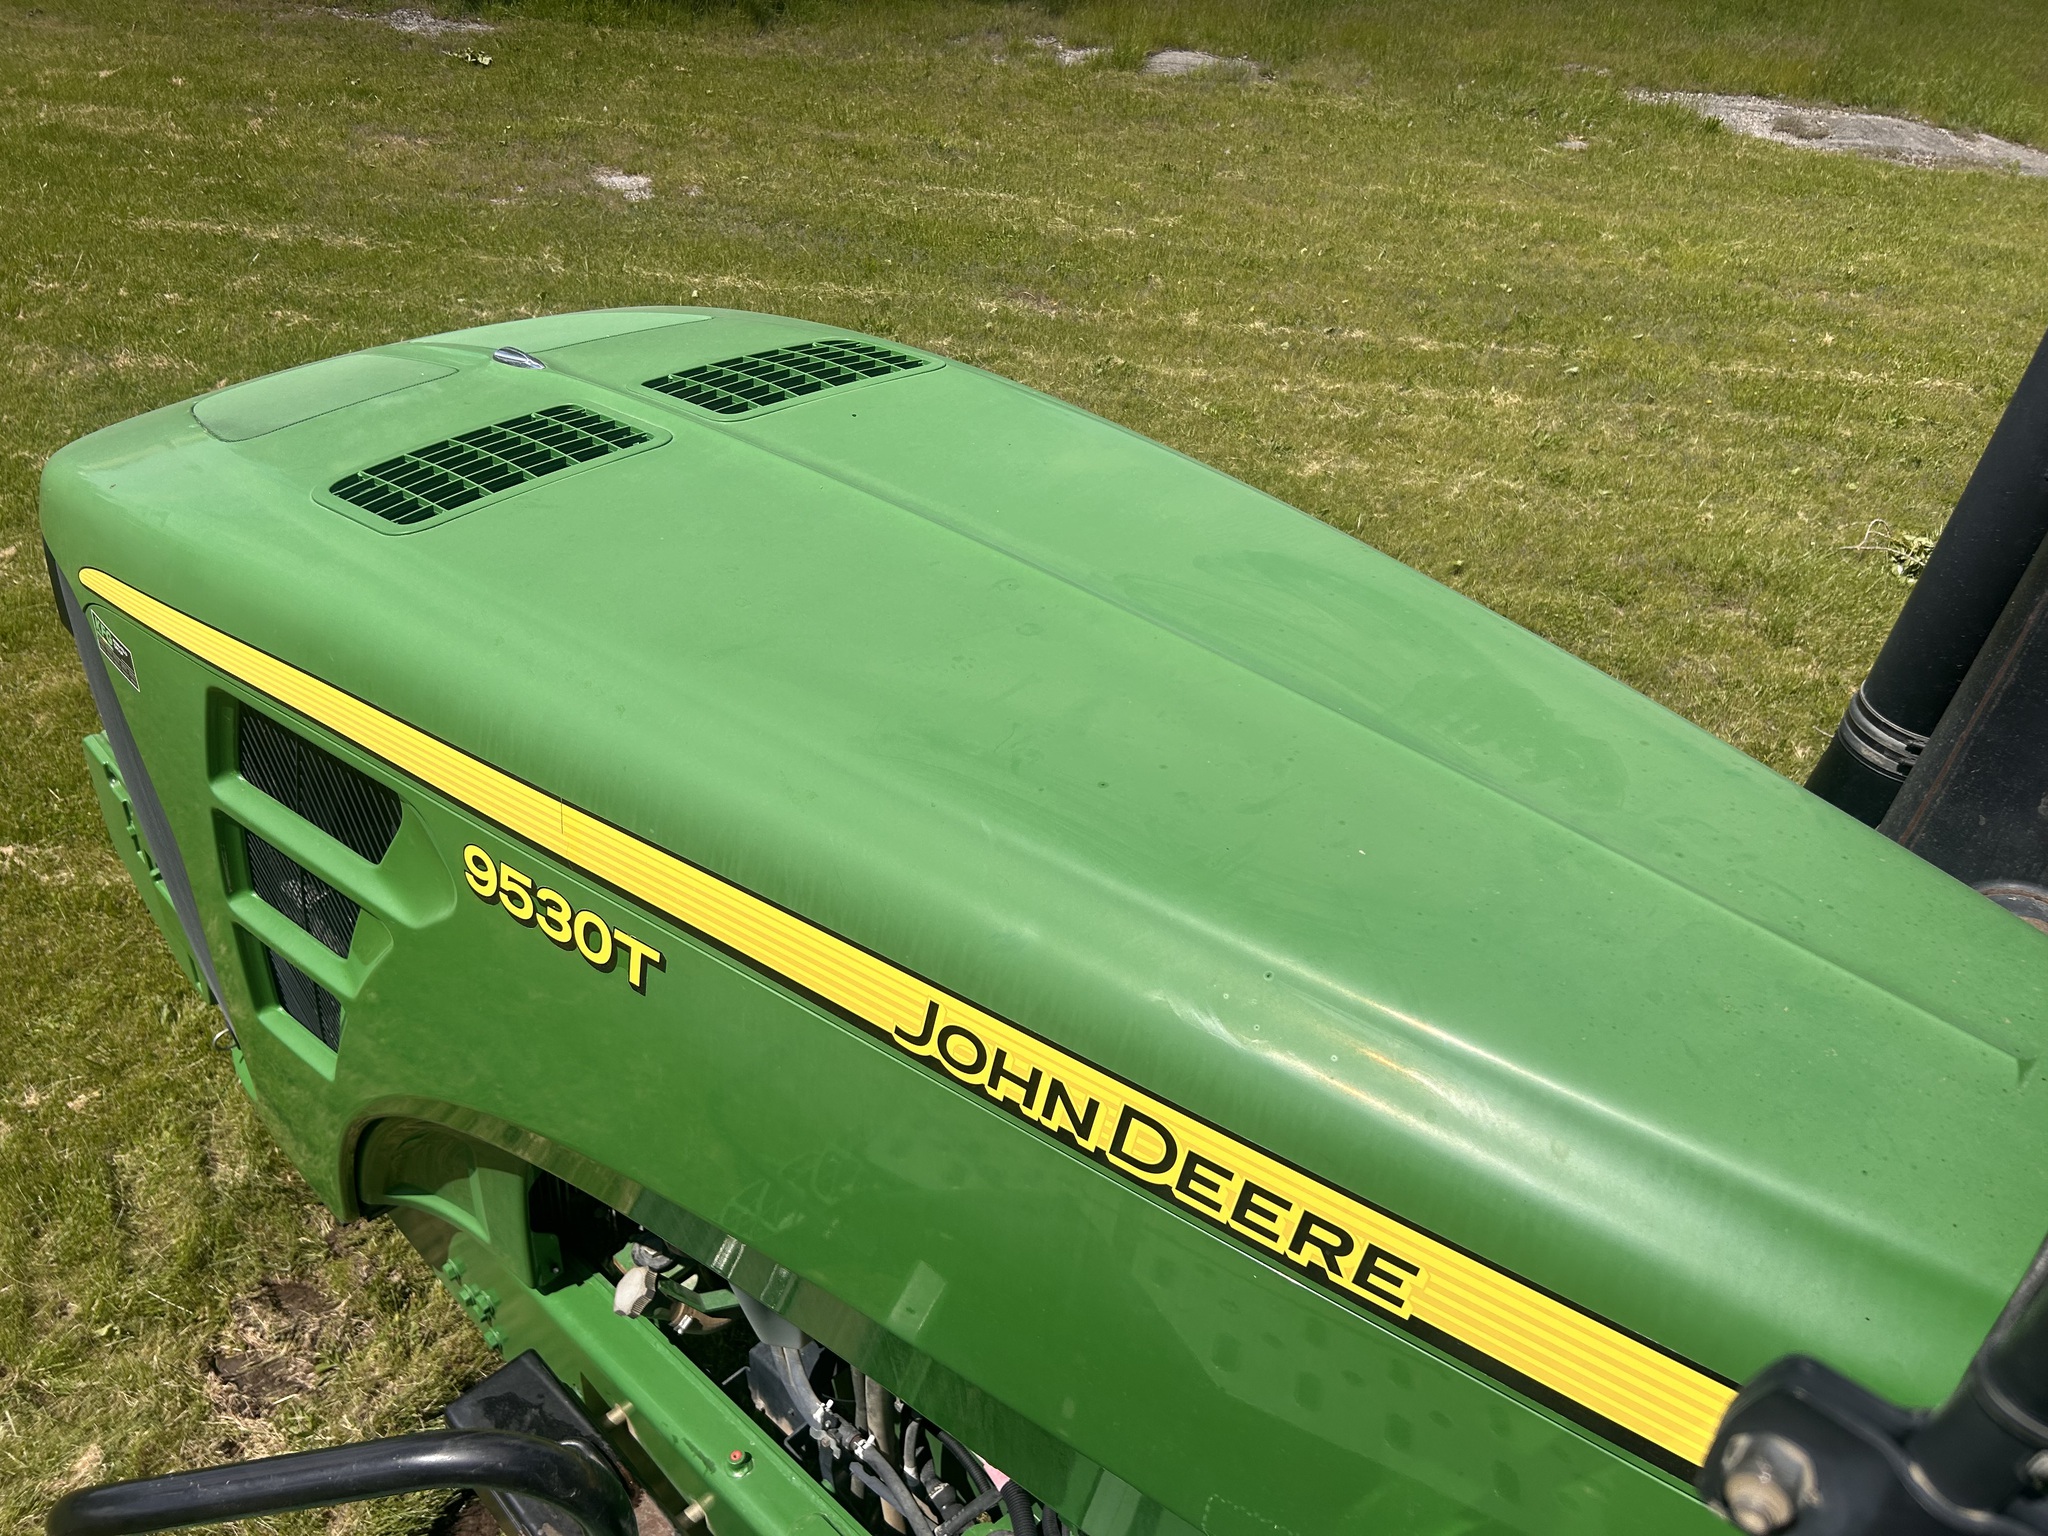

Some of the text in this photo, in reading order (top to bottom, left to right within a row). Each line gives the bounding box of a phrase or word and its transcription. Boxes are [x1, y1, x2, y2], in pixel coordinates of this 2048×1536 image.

[463, 843, 665, 995] 9530T
[893, 1000, 1420, 1309] JOHN DEERE
